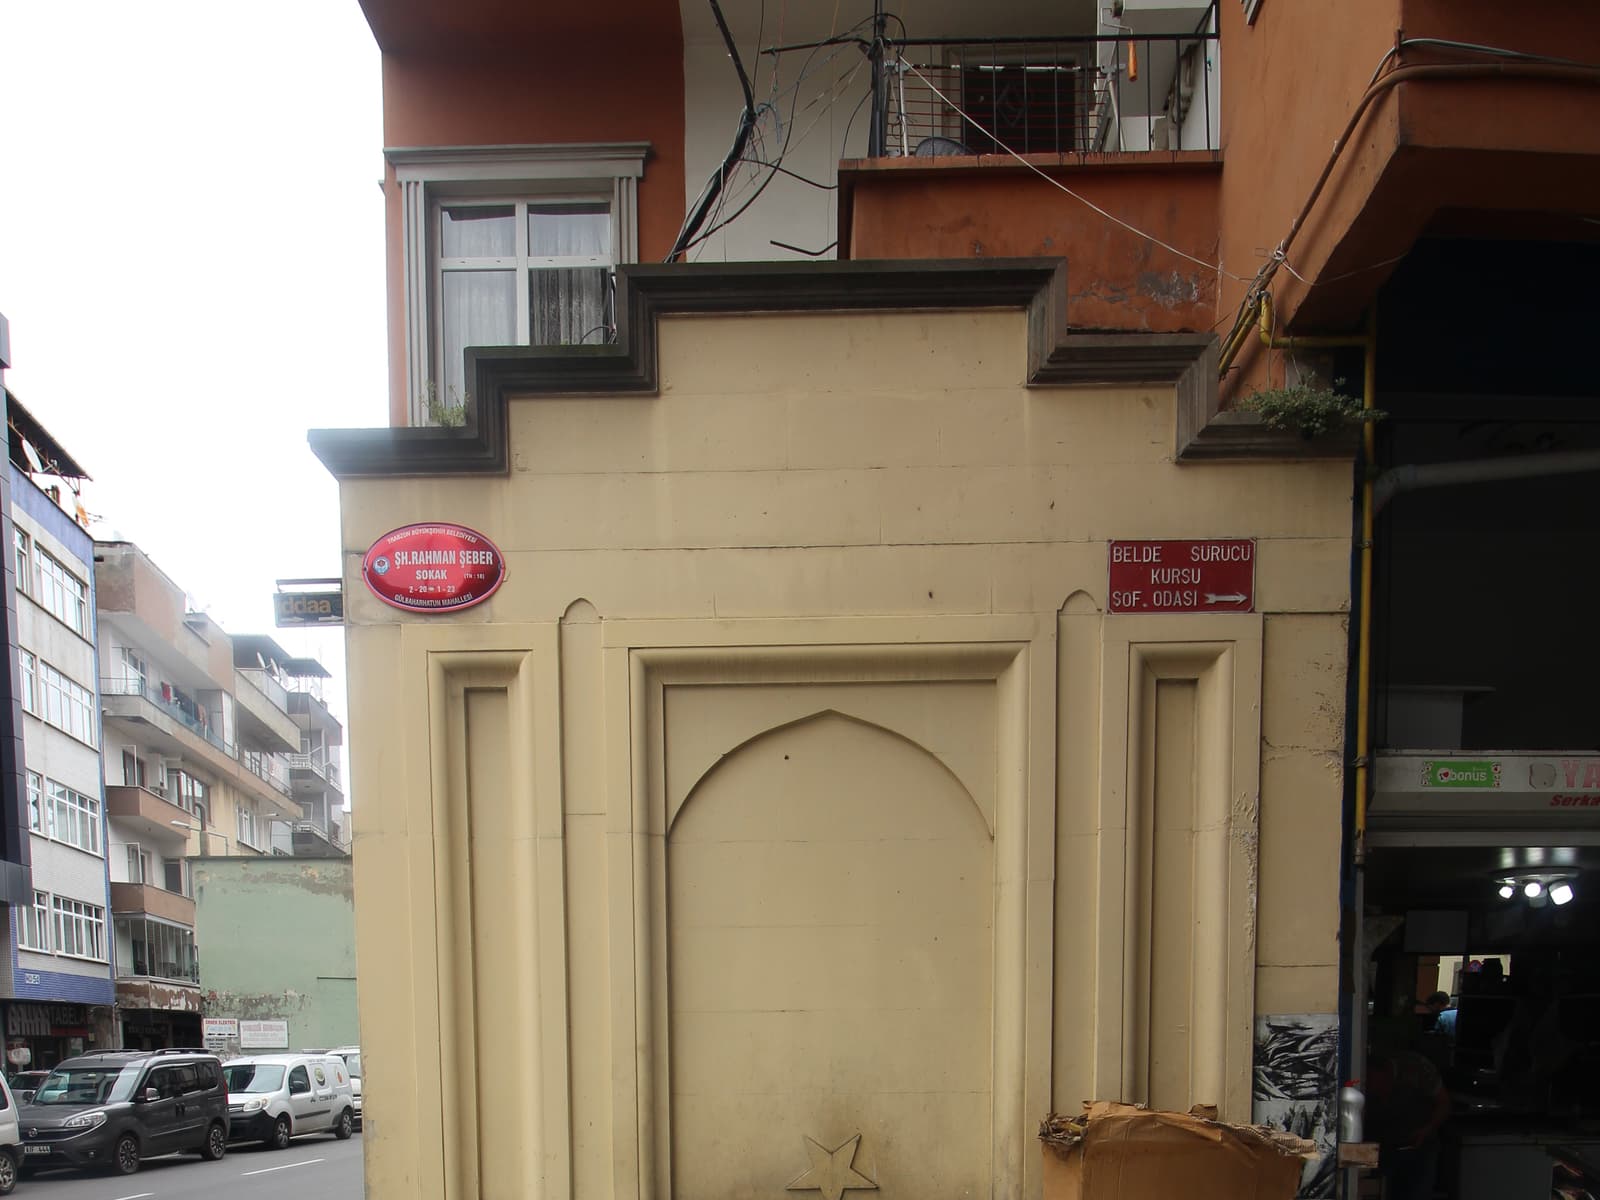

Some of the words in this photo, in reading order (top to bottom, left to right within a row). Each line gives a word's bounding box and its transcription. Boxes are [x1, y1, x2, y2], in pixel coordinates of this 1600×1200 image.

[394, 550, 456, 570] ŞH.RAHMAN
[459, 551, 493, 569] ŞEBER
[1113, 546, 1162, 563] BELDE
[415, 569, 448, 581] SOKAK
[1151, 568, 1201, 585] KURSU
[1153, 590, 1198, 607] ODASI
[1449, 768, 1488, 782] bonus
